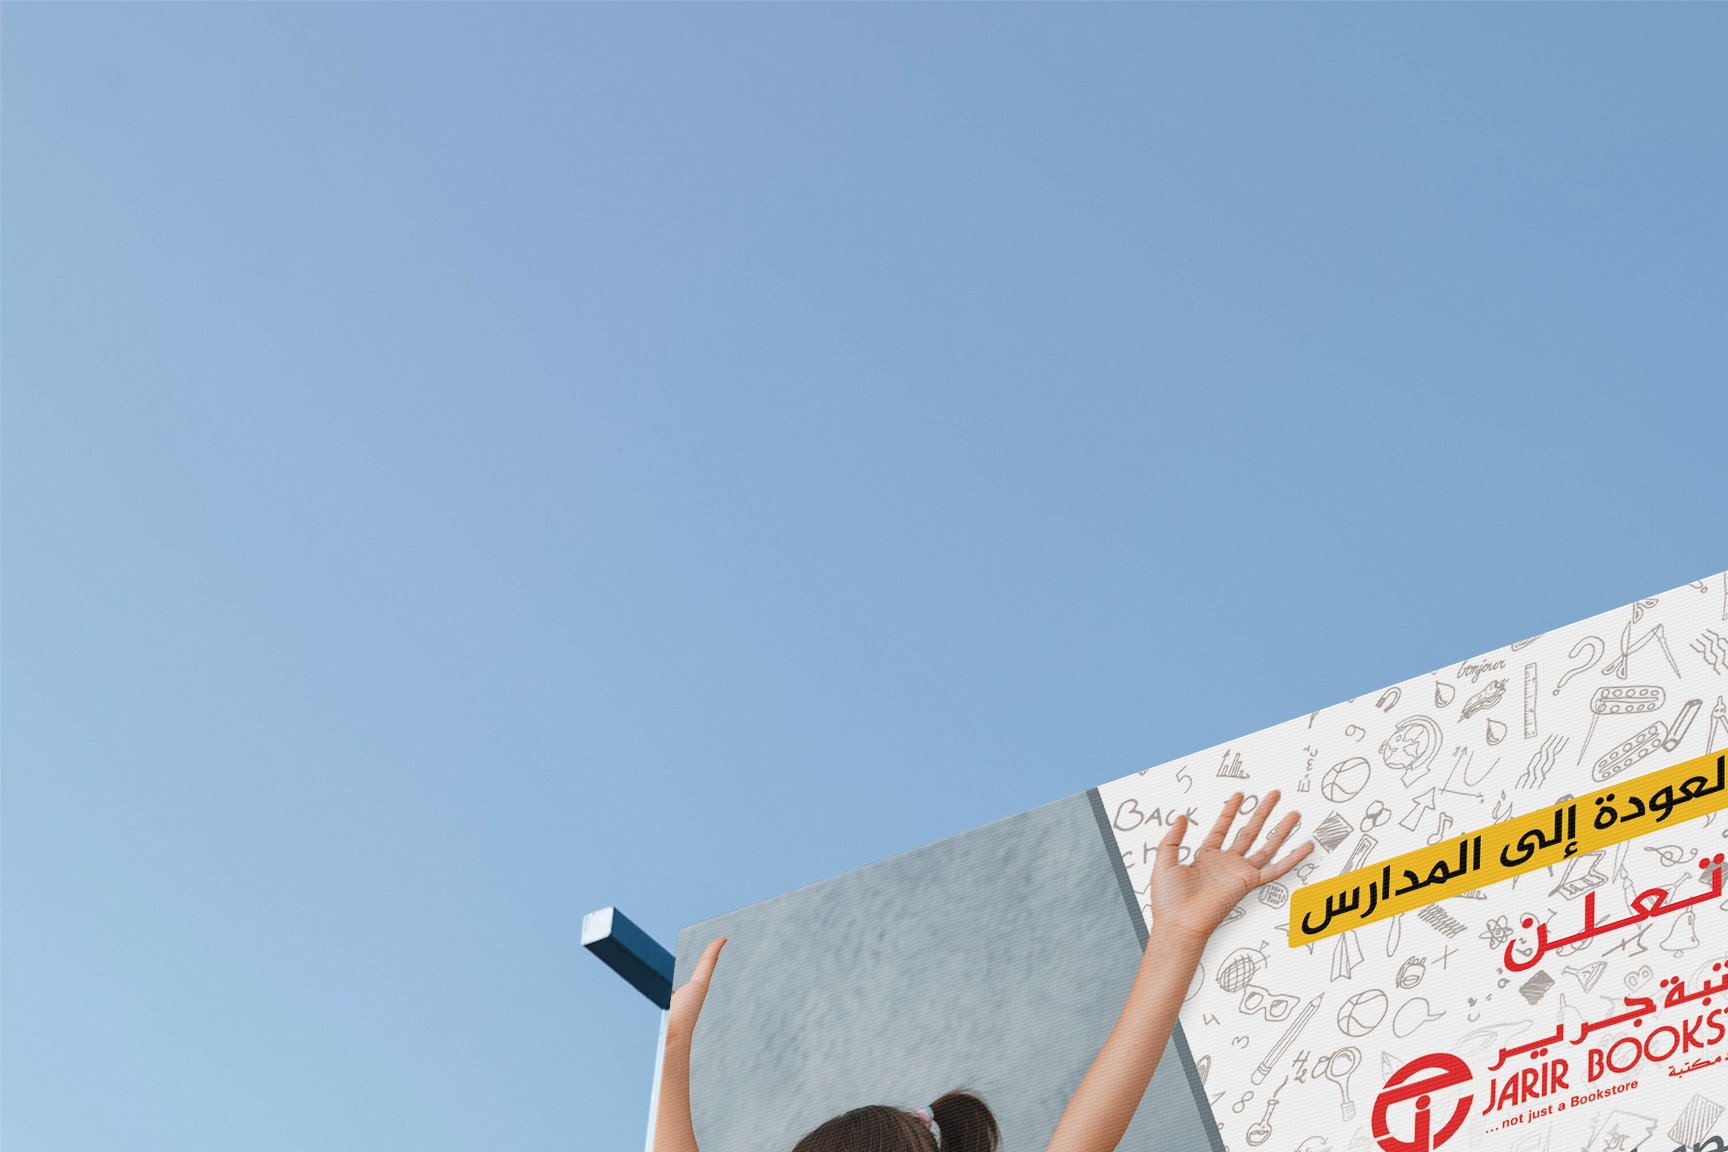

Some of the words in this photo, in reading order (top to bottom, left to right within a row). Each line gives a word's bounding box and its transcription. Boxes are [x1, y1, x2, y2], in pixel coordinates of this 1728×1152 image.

[1499, 804, 1578, 868] إلى
[1301, 835, 1482, 935] المدارس
[1504, 853, 1725, 972] تعلن
[1487, 996, 1657, 1072] جرير
[1483, 1059, 1569, 1116] JARIR
[1501, 1114, 1524, 1129] not
[1527, 1105, 1553, 1123] just
[1557, 1102, 1566, 1112] a
[1570, 1080, 1639, 1108] Bookstore
